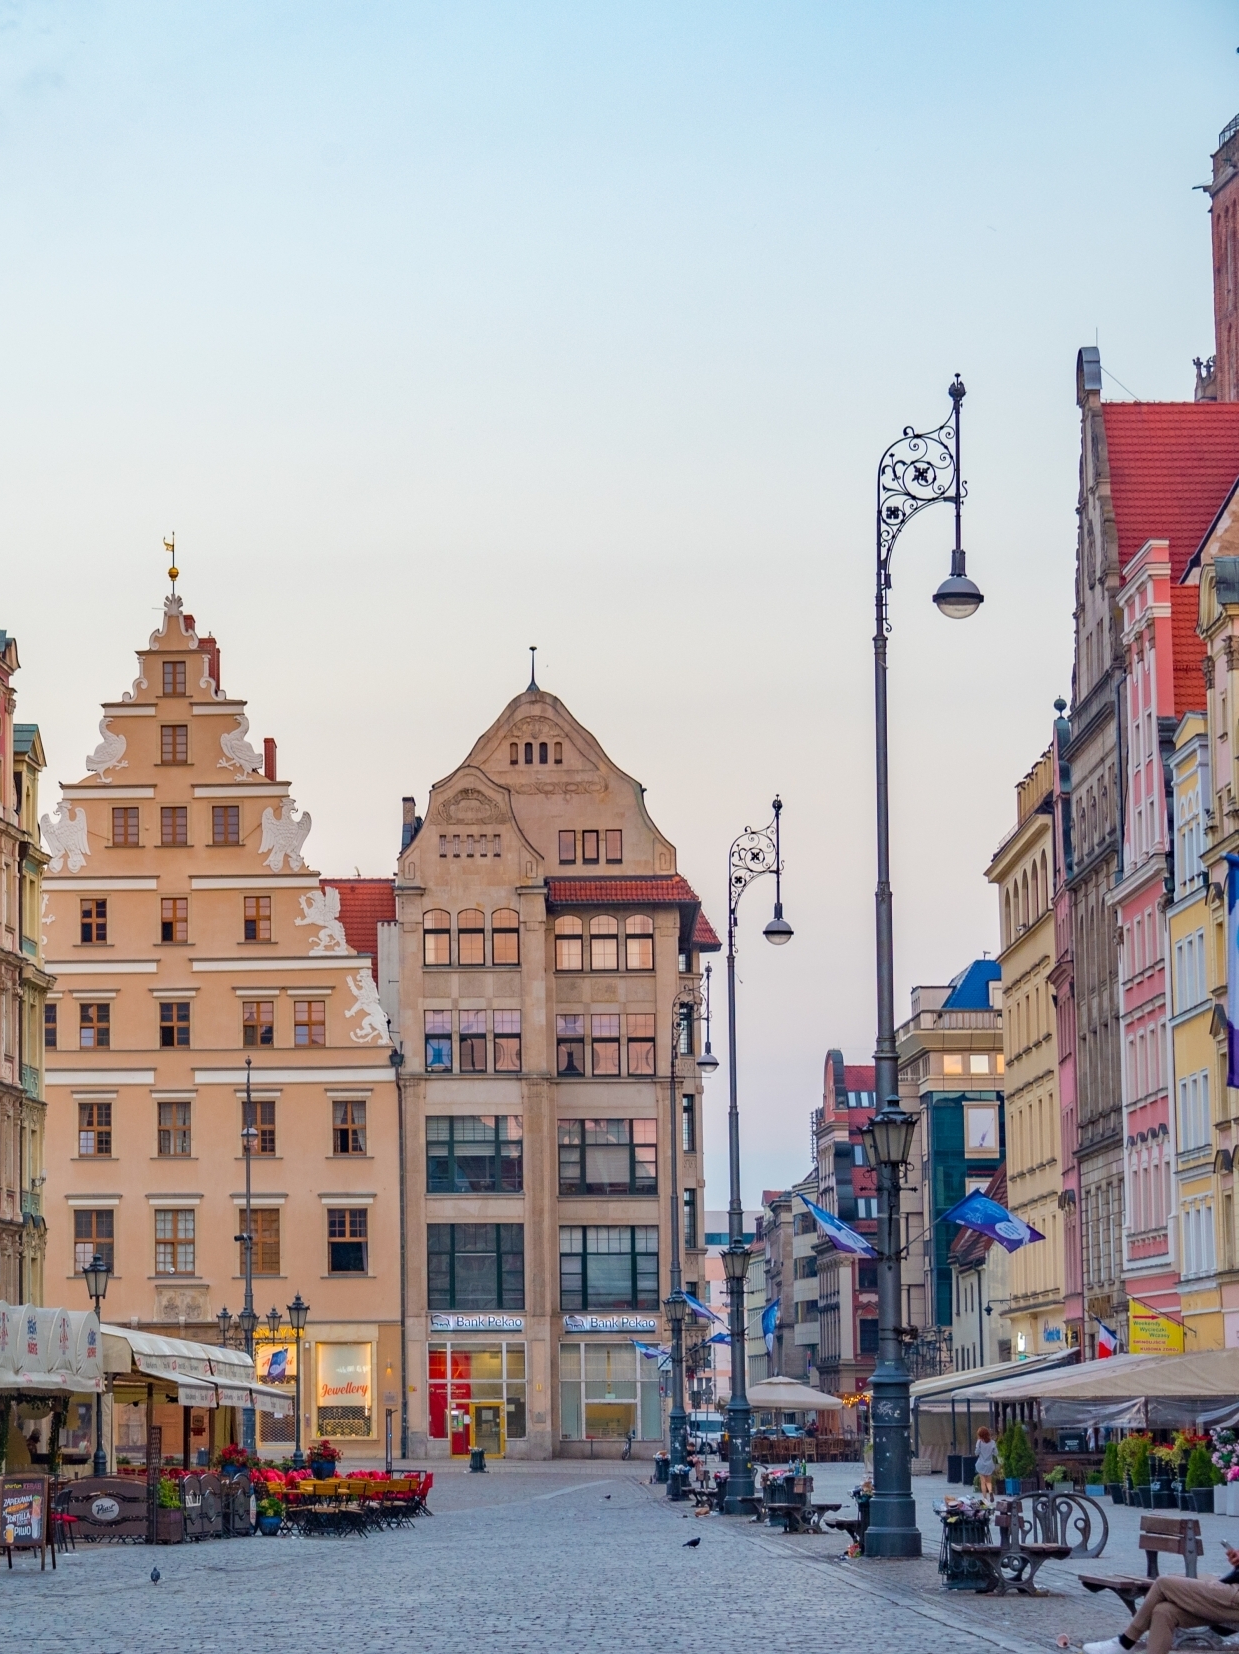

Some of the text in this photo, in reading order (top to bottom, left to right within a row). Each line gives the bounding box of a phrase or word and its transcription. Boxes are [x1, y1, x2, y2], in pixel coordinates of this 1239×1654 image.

[456, 1316, 522, 1328] Bank Pekao
[590, 1317, 656, 1328] Bank Pekao
[321, 1382, 368, 1398] Jewellery
[3, 1494, 33, 1508] ZAPIEKANKA
[6, 1508, 31, 1524] TORTILLA
[14, 1526, 32, 1536] PIWO
